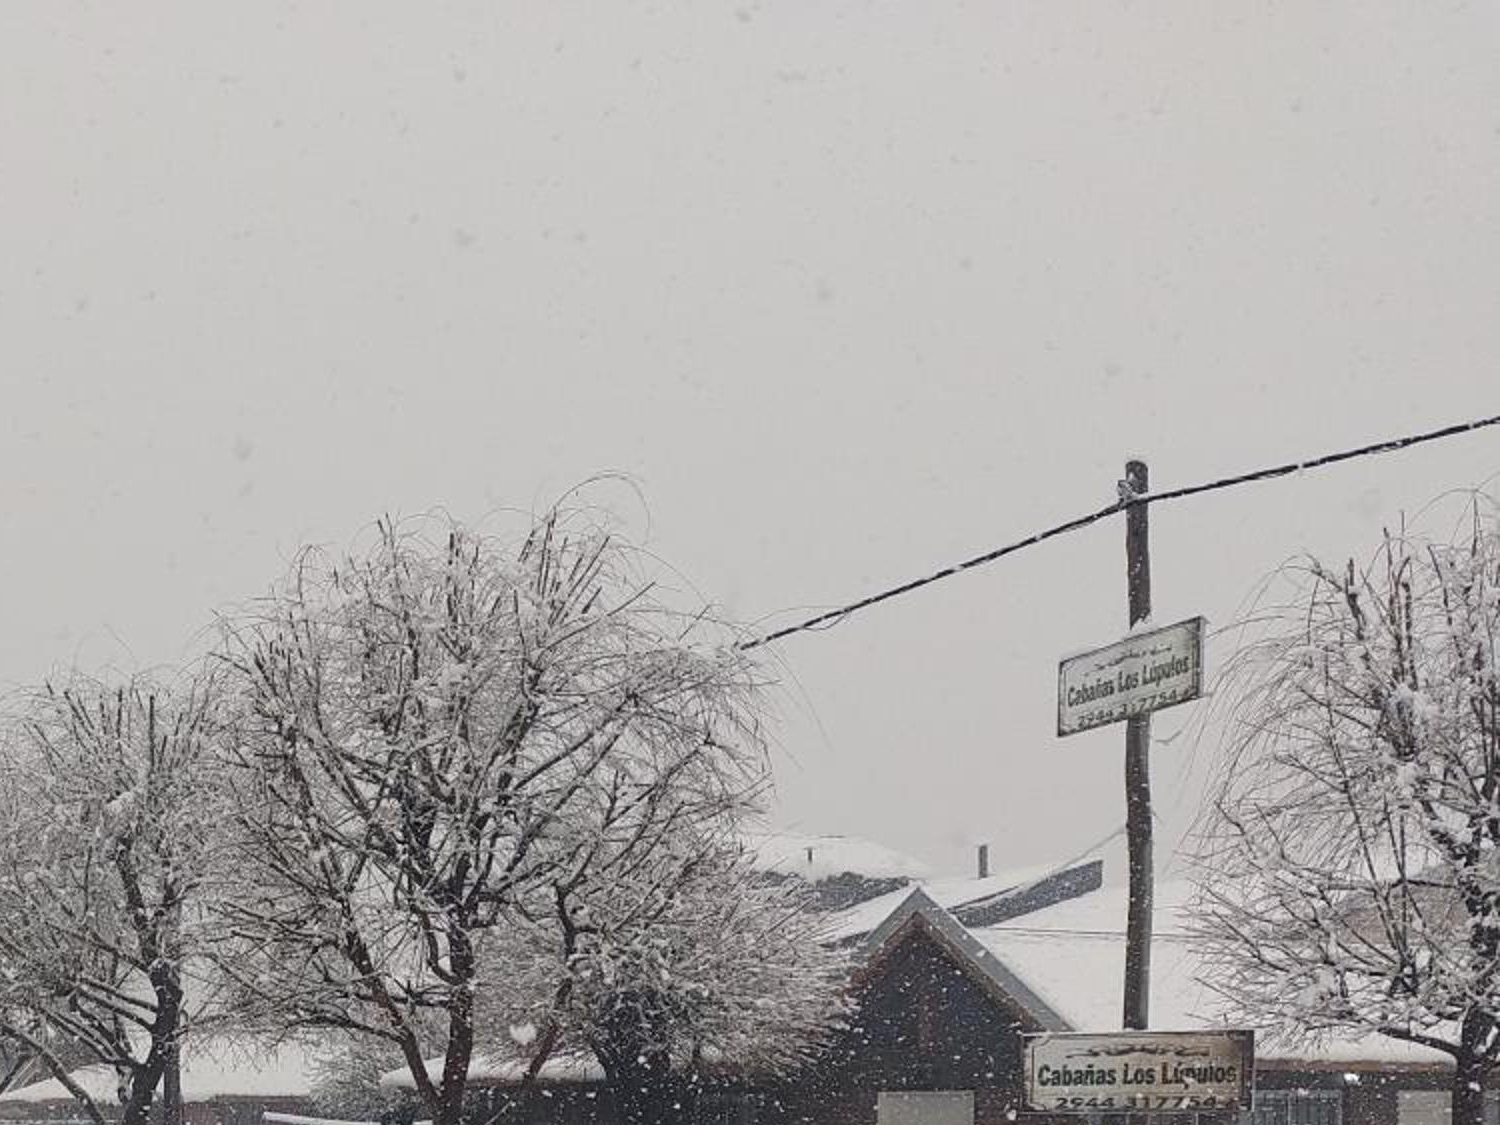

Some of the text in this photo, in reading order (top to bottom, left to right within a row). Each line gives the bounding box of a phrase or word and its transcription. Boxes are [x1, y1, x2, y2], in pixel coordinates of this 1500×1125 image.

[1067, 677, 1114, 708] Cabañas
[1118, 671, 1139, 693] Los
[1038, 1061, 1237, 1090] Cabañas Los Lúpulos
[1056, 1096, 1115, 1109] 2944
